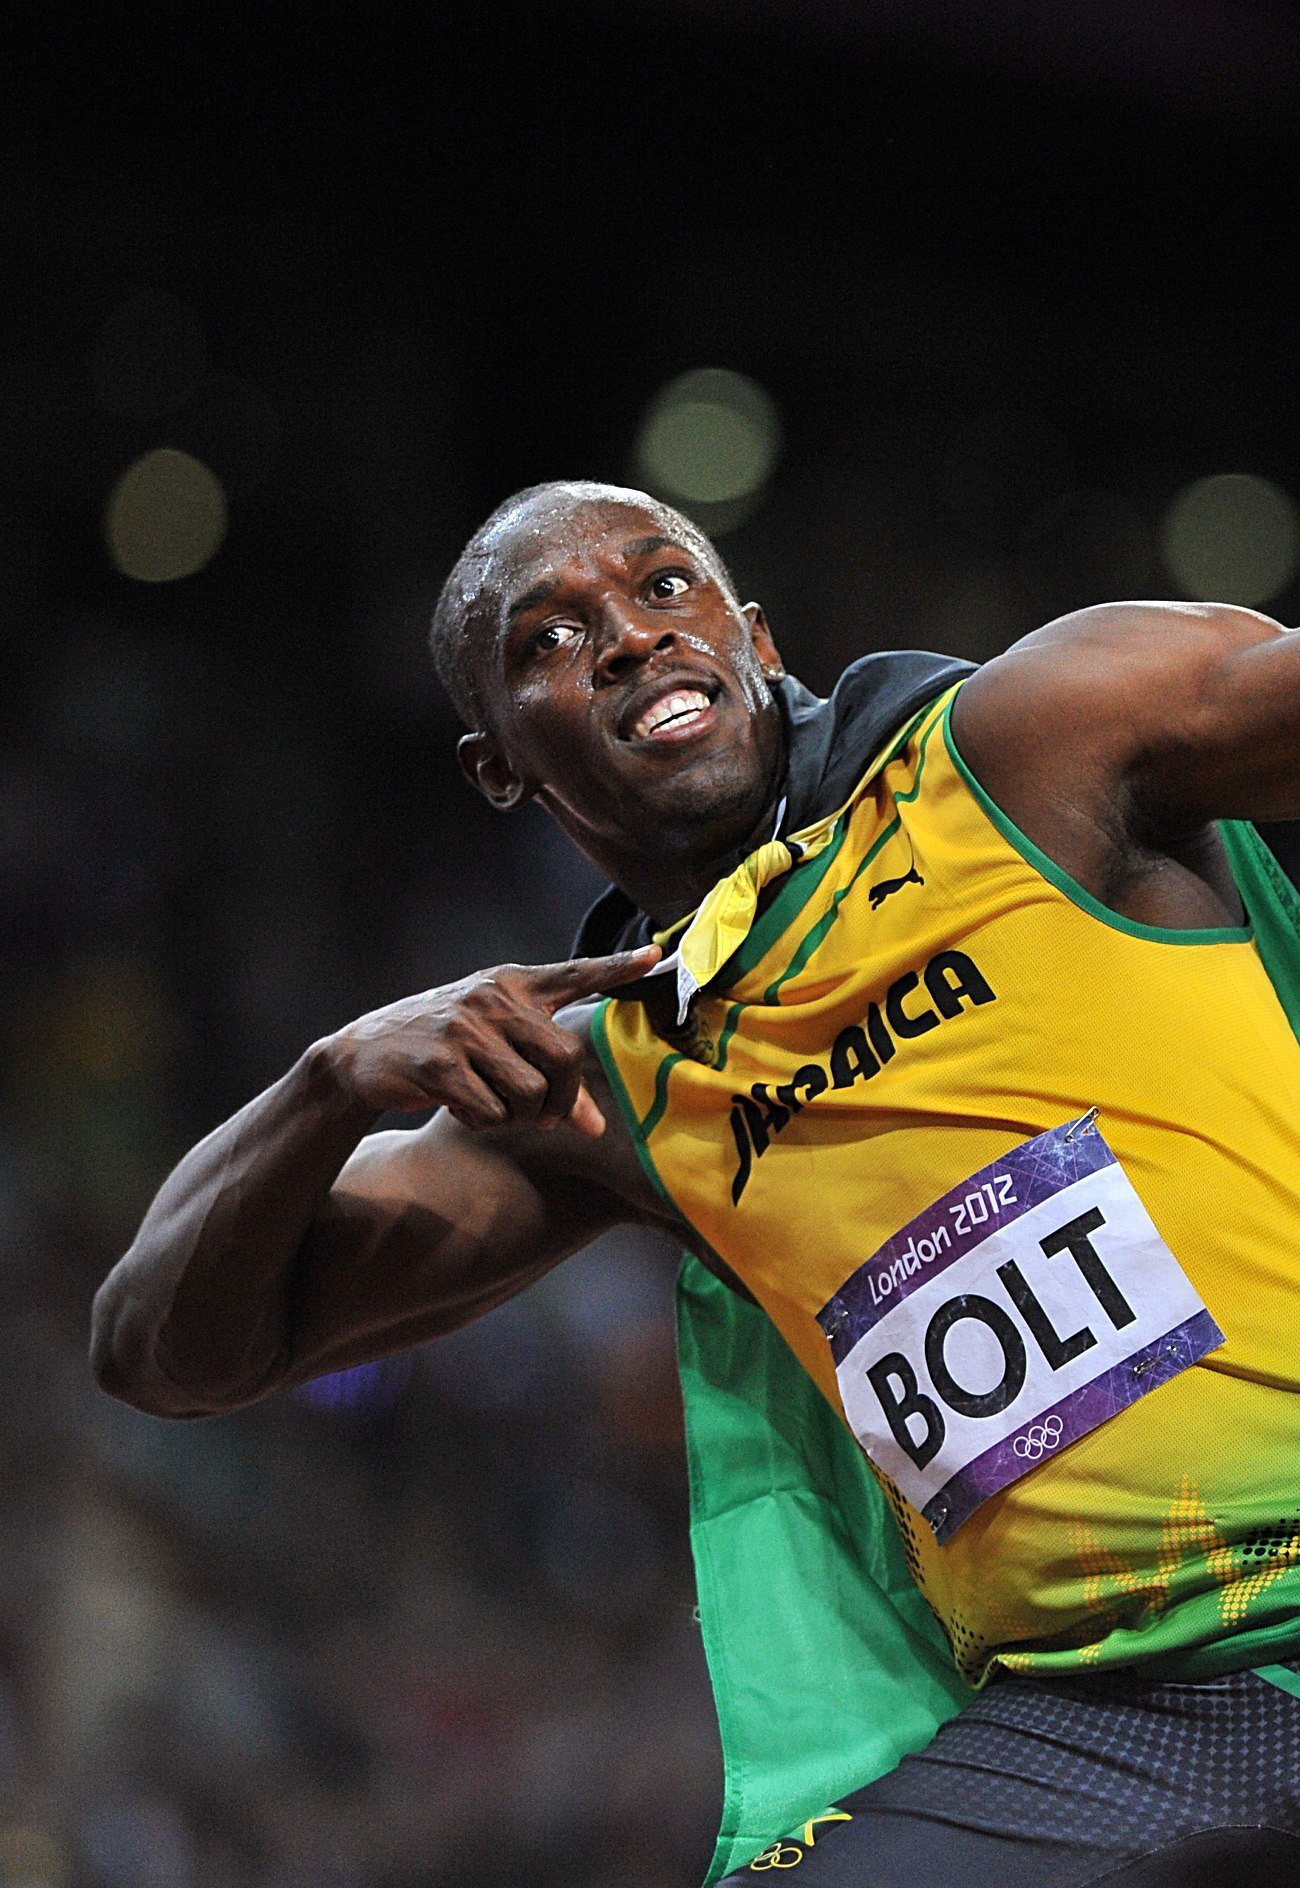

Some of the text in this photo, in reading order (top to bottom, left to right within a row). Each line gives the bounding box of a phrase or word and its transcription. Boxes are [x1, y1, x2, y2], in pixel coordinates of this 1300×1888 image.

[866, 1206, 1137, 1471] BOLT
[867, 1174, 1017, 1305] London 2012
